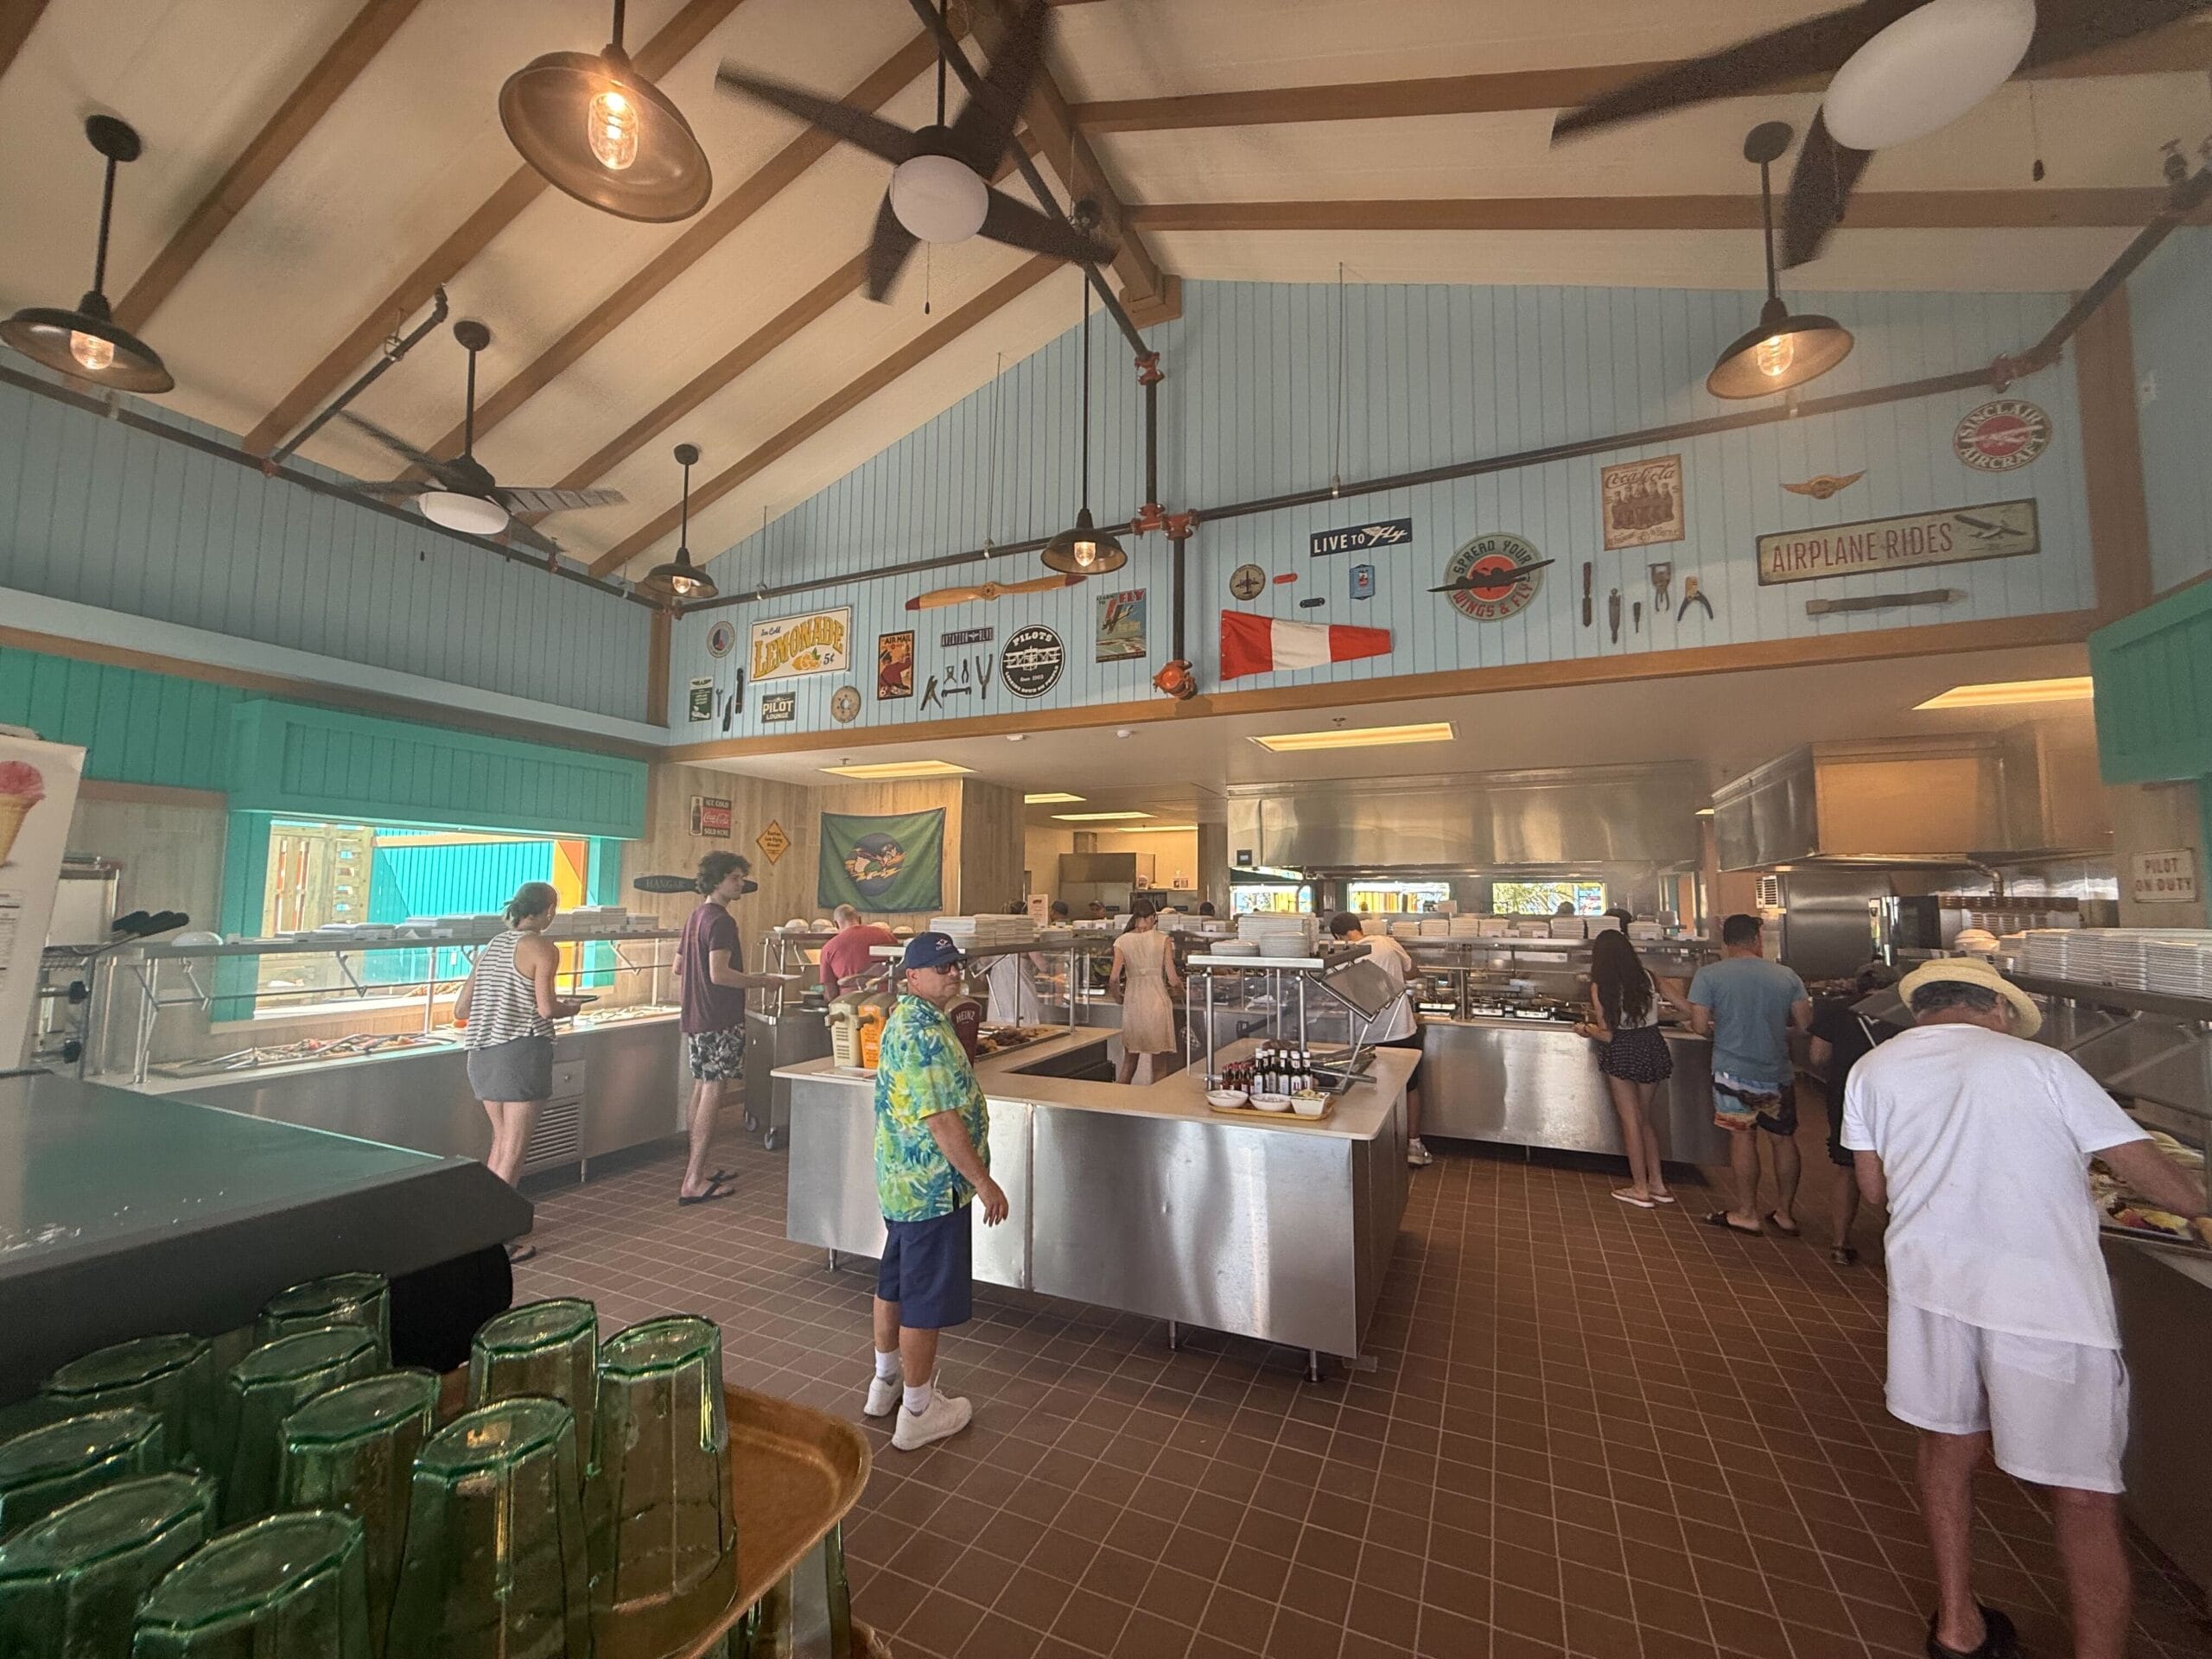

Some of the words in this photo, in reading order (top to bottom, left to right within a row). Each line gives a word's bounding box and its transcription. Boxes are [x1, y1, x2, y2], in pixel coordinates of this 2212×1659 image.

[1959, 404, 2043, 437] SINCLAIR
[1959, 437, 2044, 467] AIRCRAFT
[1313, 534, 1348, 553] LIVE
[1351, 533, 1365, 545] TO
[1772, 531, 1877, 573] AIRPLANE
[1885, 522, 1953, 559] RIDES
[1453, 540, 1495, 574] SPREAD
[1503, 540, 1532, 564] YOUR
[1118, 589, 1146, 604] FLY
[1452, 590, 1494, 617] WINGS
[1499, 603, 1510, 614] &
[1510, 583, 1533, 607] FLY
[769, 626, 781, 635] Cold
[897, 635, 912, 644] MAIL
[1013, 632, 1052, 646] PILOTS
[753, 616, 845, 678] LEMONADE
[823, 653, 835, 665] 5¢
[762, 700, 794, 715] PILOT
[2145, 857, 2177, 874] PILOT
[645, 878, 685, 889] HANGAR
[2135, 880, 2152, 892] ON
[2157, 877, 2192, 892] DUTY
[956, 1011, 976, 1022] HEINZ
